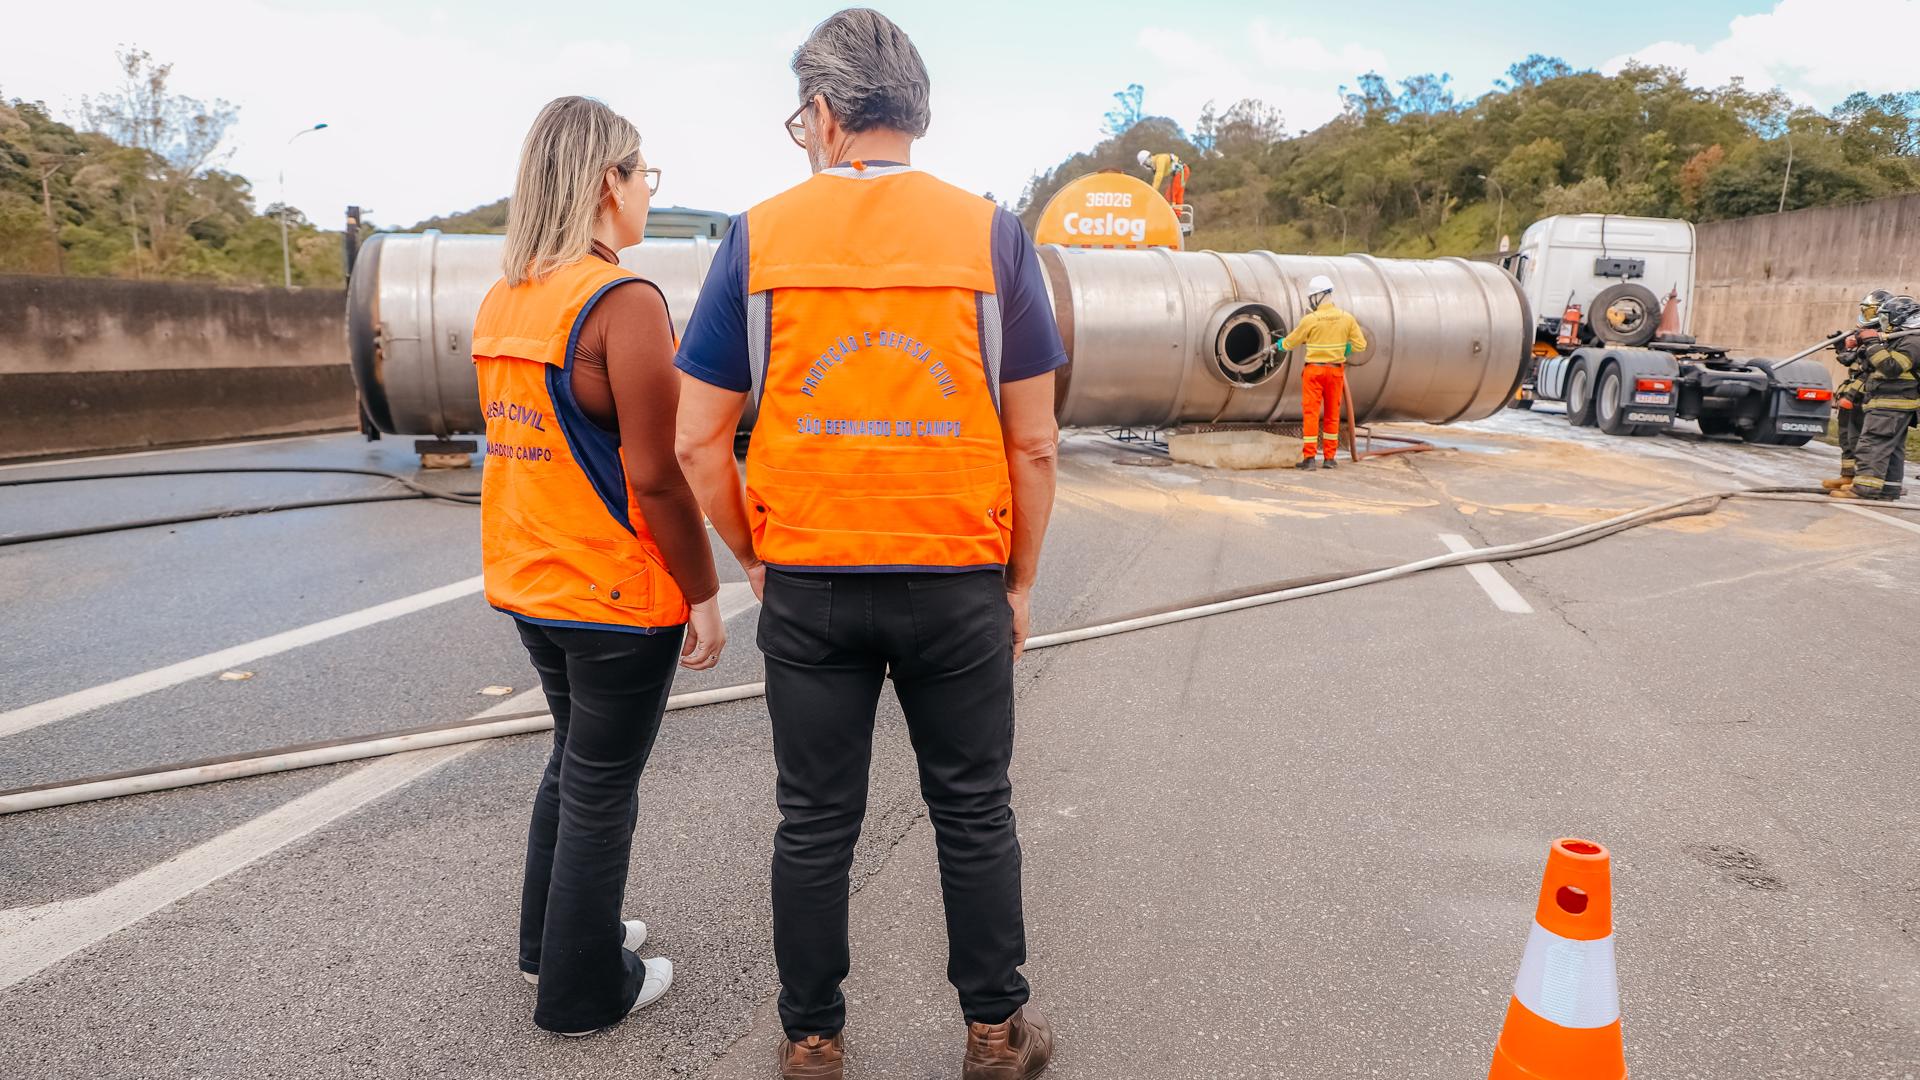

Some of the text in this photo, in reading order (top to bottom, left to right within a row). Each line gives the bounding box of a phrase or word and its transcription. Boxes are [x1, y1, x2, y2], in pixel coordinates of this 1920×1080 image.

[1086, 192, 1132, 208] 36026
[1063, 212, 1147, 242] Ceslog
[800, 330, 958, 400] PROTEÇÃO E DEFESA CIVIL
[508, 403, 546, 433] CIVIL
[797, 414, 961, 438] SÃO BERNARDO DO CAMPO
[1628, 412, 1671, 423] SCANIA
[1781, 422, 1824, 433] SCANIA
[516, 446, 552, 462] CAMPO
